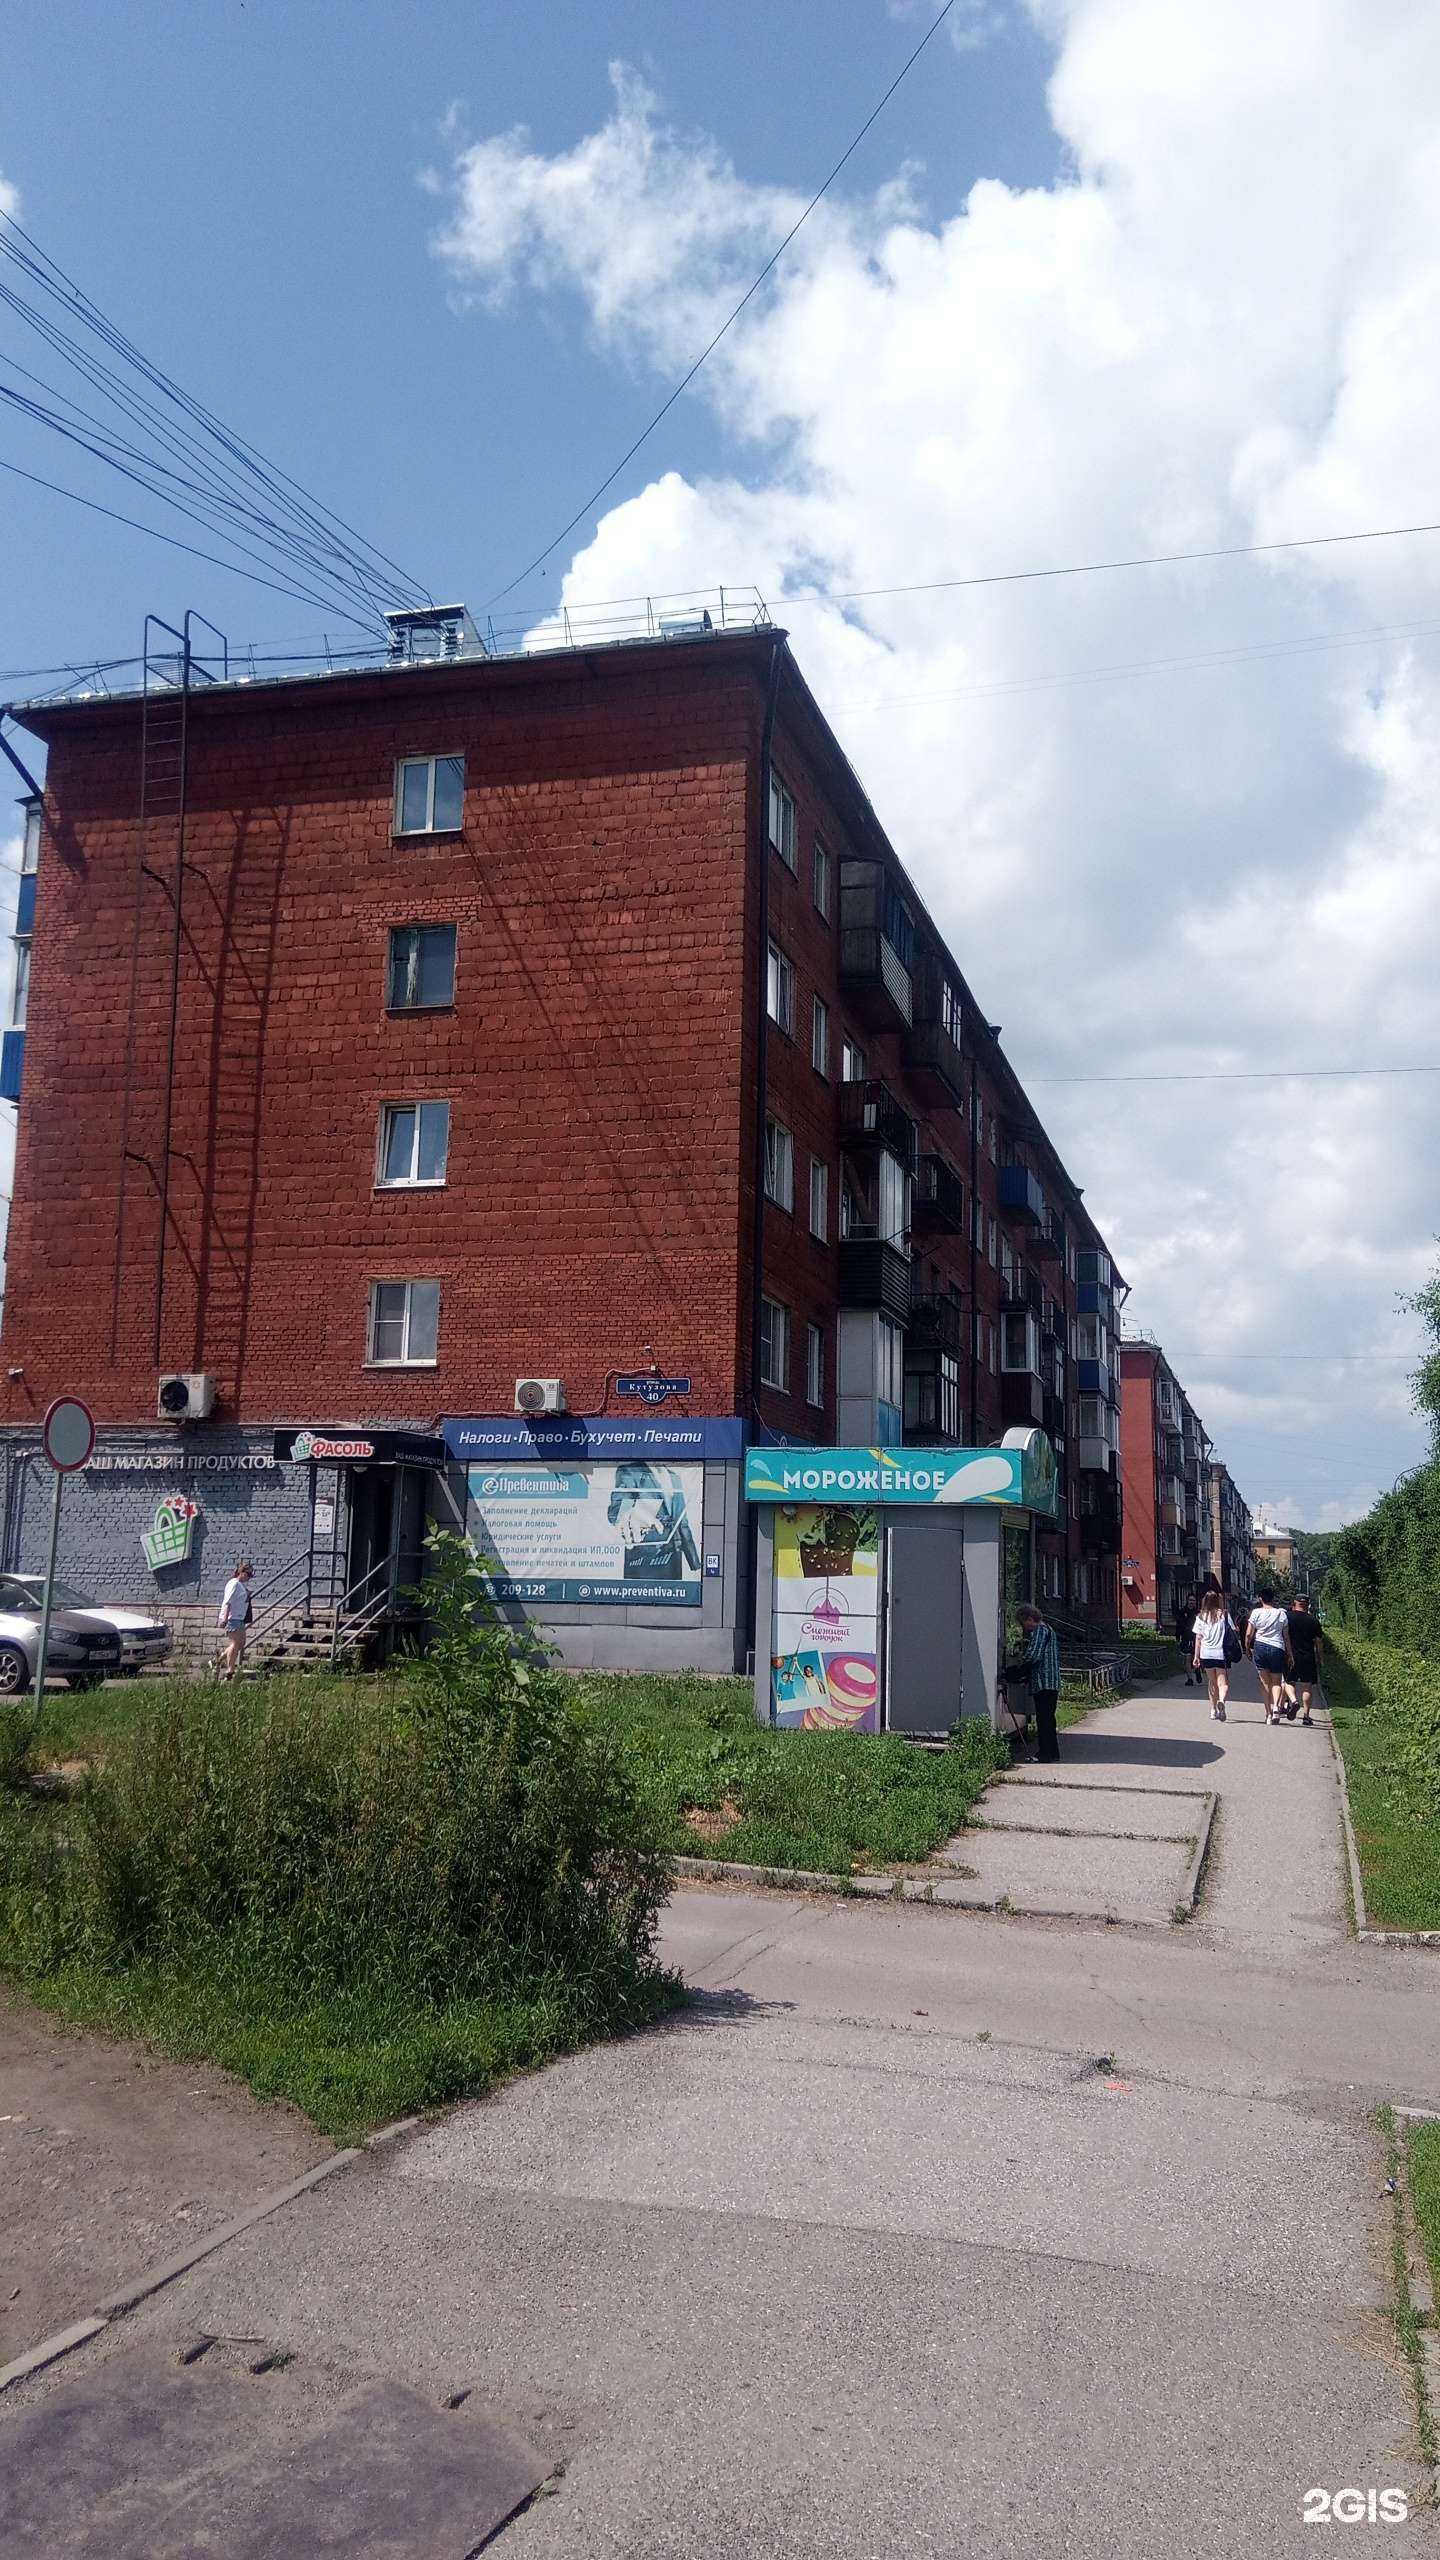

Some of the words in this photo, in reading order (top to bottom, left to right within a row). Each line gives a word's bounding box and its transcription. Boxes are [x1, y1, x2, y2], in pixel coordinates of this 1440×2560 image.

[646, 1393, 659, 1401] 40
[459, 1431, 511, 1444] Налоги
[518, 1431, 563, 1444] Право
[570, 1431, 635, 1444] Бухучет
[644, 1430, 702, 1444] Печати
[311, 1439, 375, 1457] ФАСОЛЬ
[82, 1455, 112, 1470] АШ
[114, 1455, 184, 1470] МАГАЗИН
[187, 1455, 275, 1471] ПРОДУКТОВ
[783, 1470, 945, 1491] МОРОЖЕНОЕ
[502, 1584, 546, 1596] 209-128
[594, 1585, 686, 1599] www.preventiva.ru
